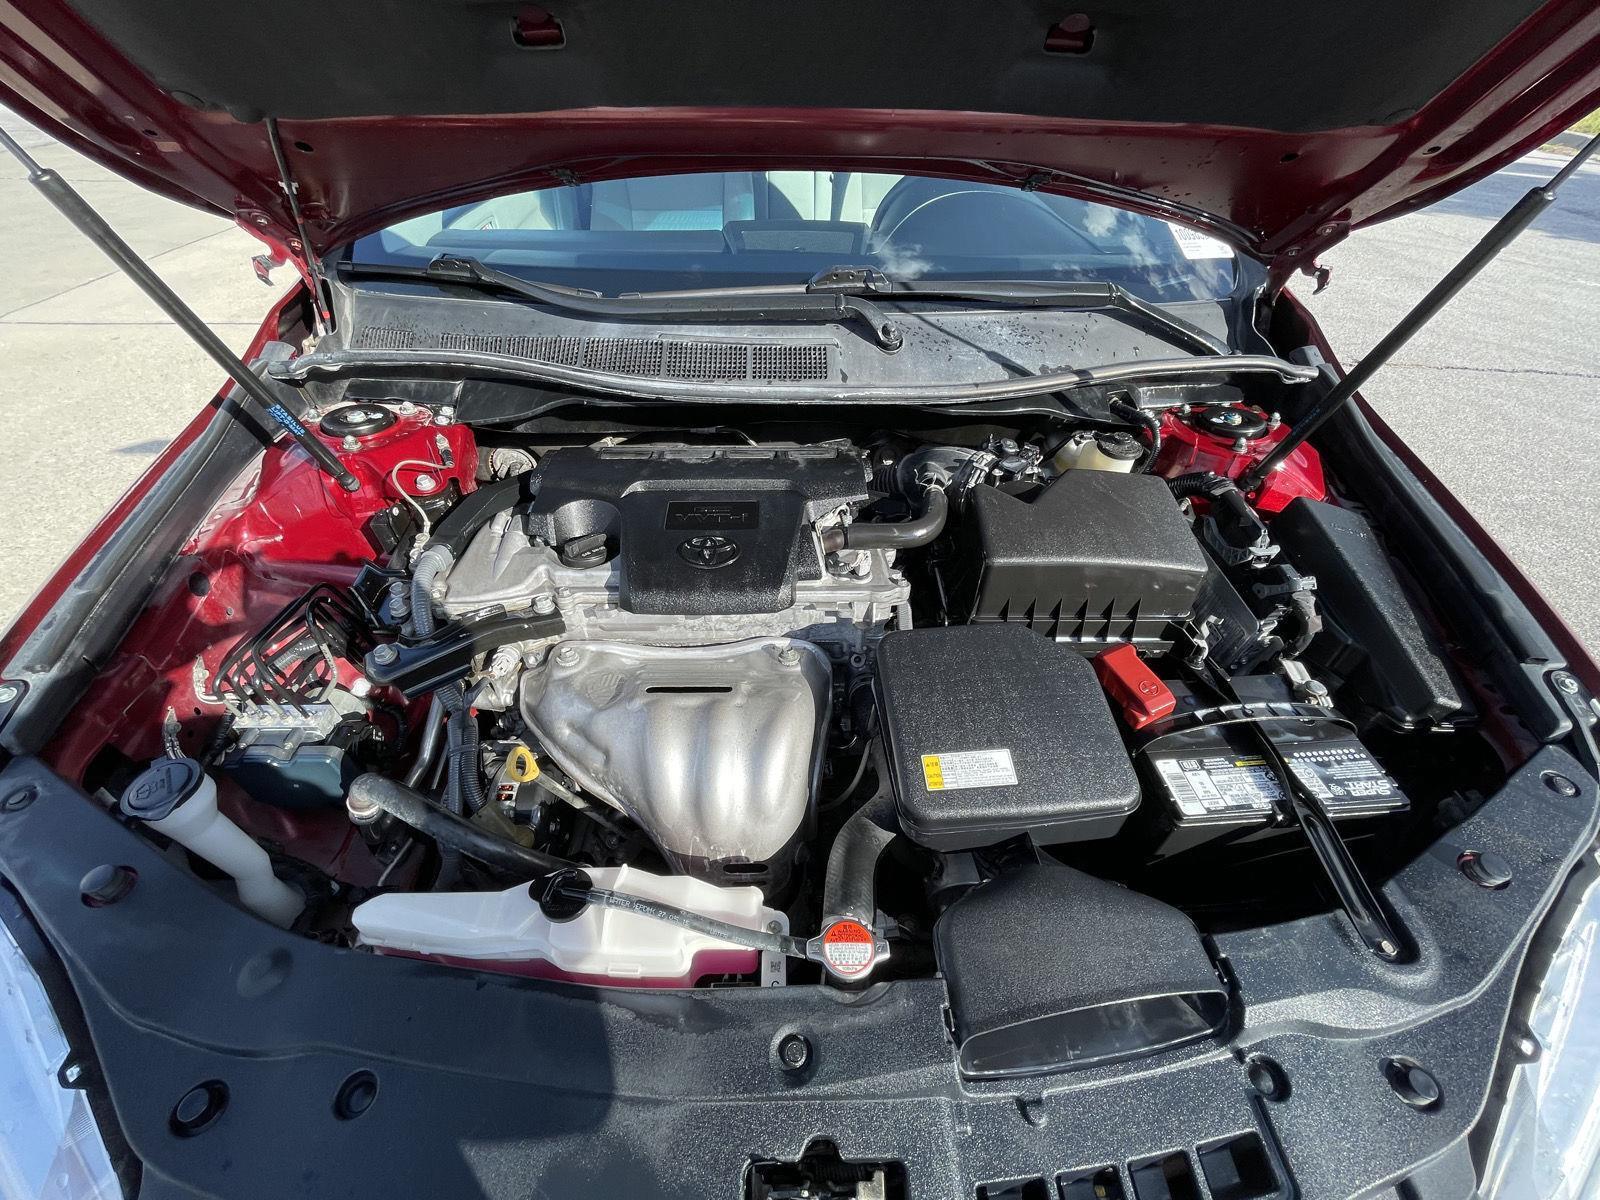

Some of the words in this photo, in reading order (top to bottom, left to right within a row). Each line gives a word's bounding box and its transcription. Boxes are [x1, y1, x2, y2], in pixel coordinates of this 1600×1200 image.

[275, 404, 305, 434] STABILUS
[1350, 788, 1391, 797] SUPER
[609, 896, 631, 908] WATER
